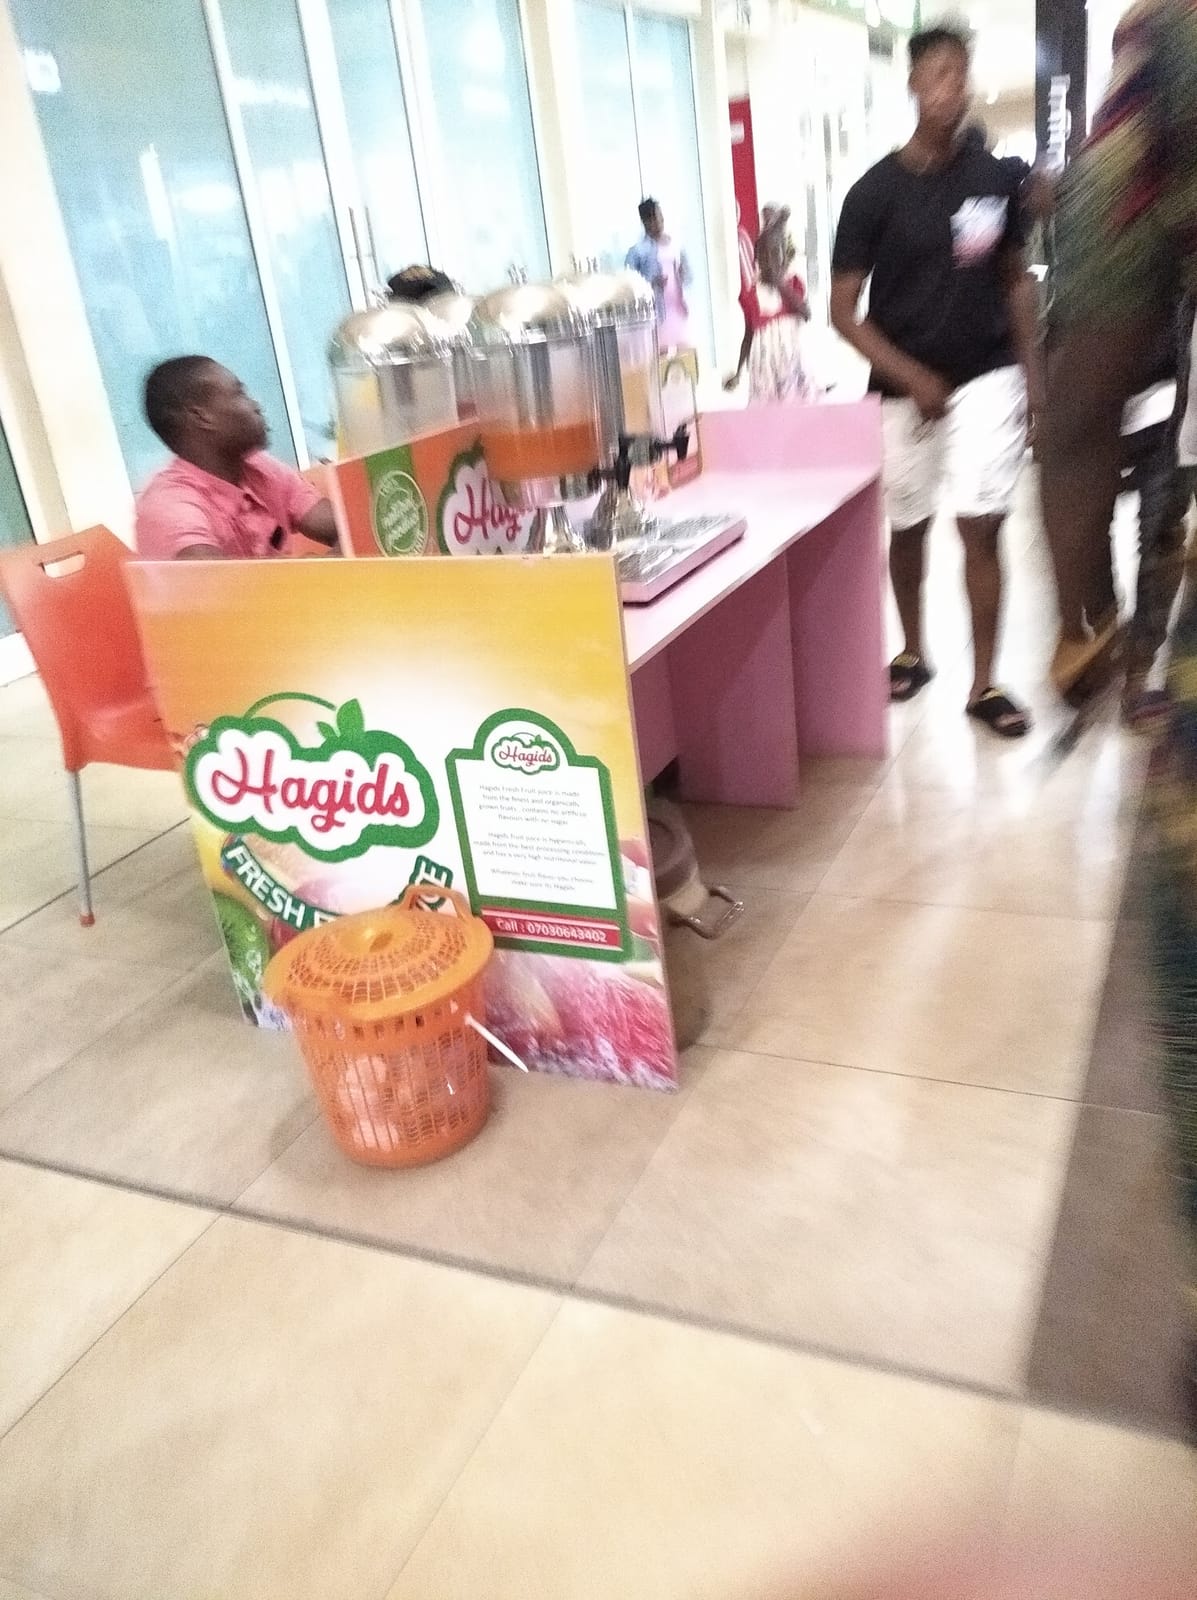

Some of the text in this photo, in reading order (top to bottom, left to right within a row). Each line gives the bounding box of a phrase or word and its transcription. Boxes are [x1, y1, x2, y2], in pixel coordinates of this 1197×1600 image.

[499, 745, 553, 767] Hagids
[211, 747, 410, 833] Hagids
[225, 844, 306, 929] FRESH
[496, 917, 519, 933] Call
[527, 921, 608, 943] 07030643402
